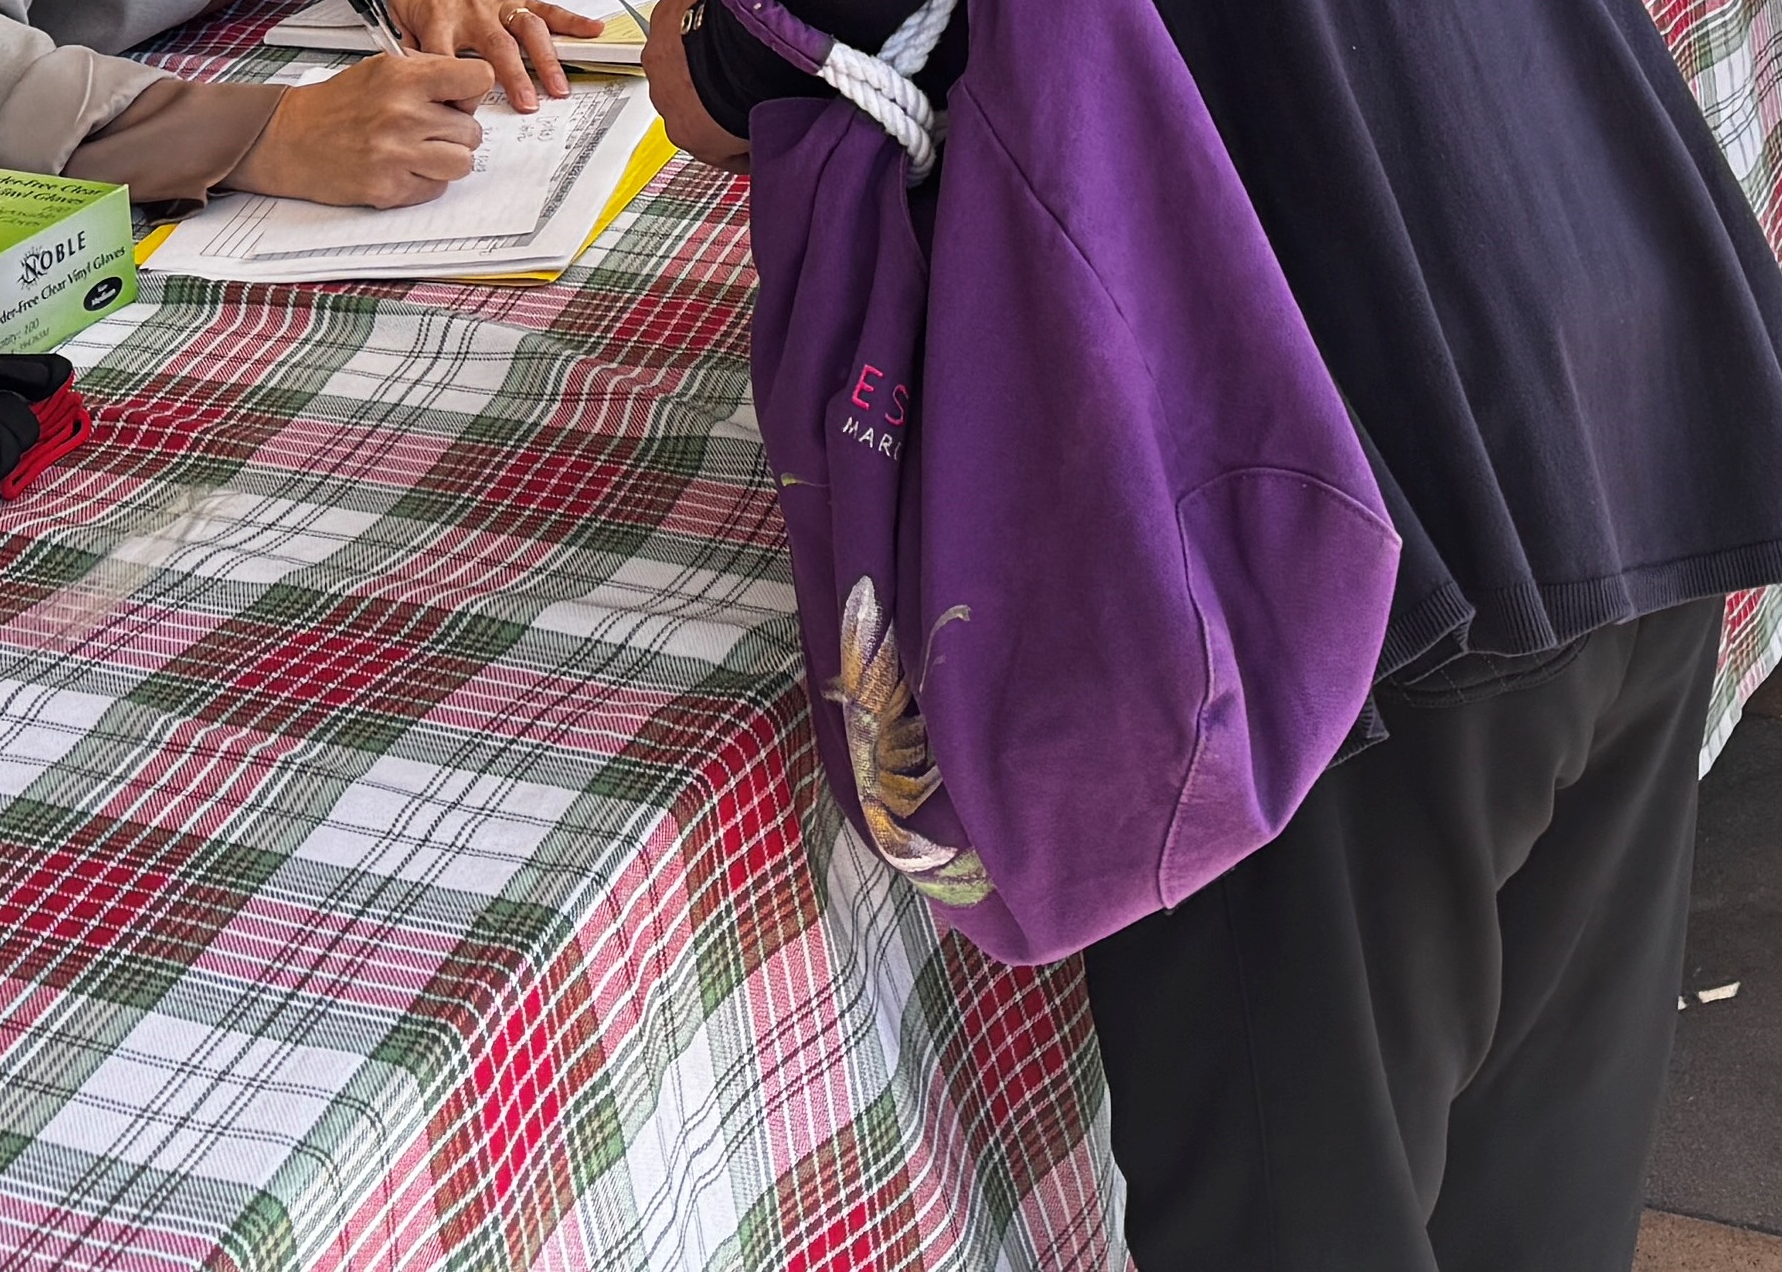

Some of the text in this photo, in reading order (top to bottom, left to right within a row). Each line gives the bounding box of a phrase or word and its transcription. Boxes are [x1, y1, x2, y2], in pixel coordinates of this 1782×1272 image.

[33, 191, 86, 206] Gloves
[60, 181, 103, 197] Clear
[19, 231, 87, 285] NOBLE
[41, 279, 67, 300] Clear
[67, 263, 92, 285] Vinyl
[92, 246, 126, 270] Gloves
